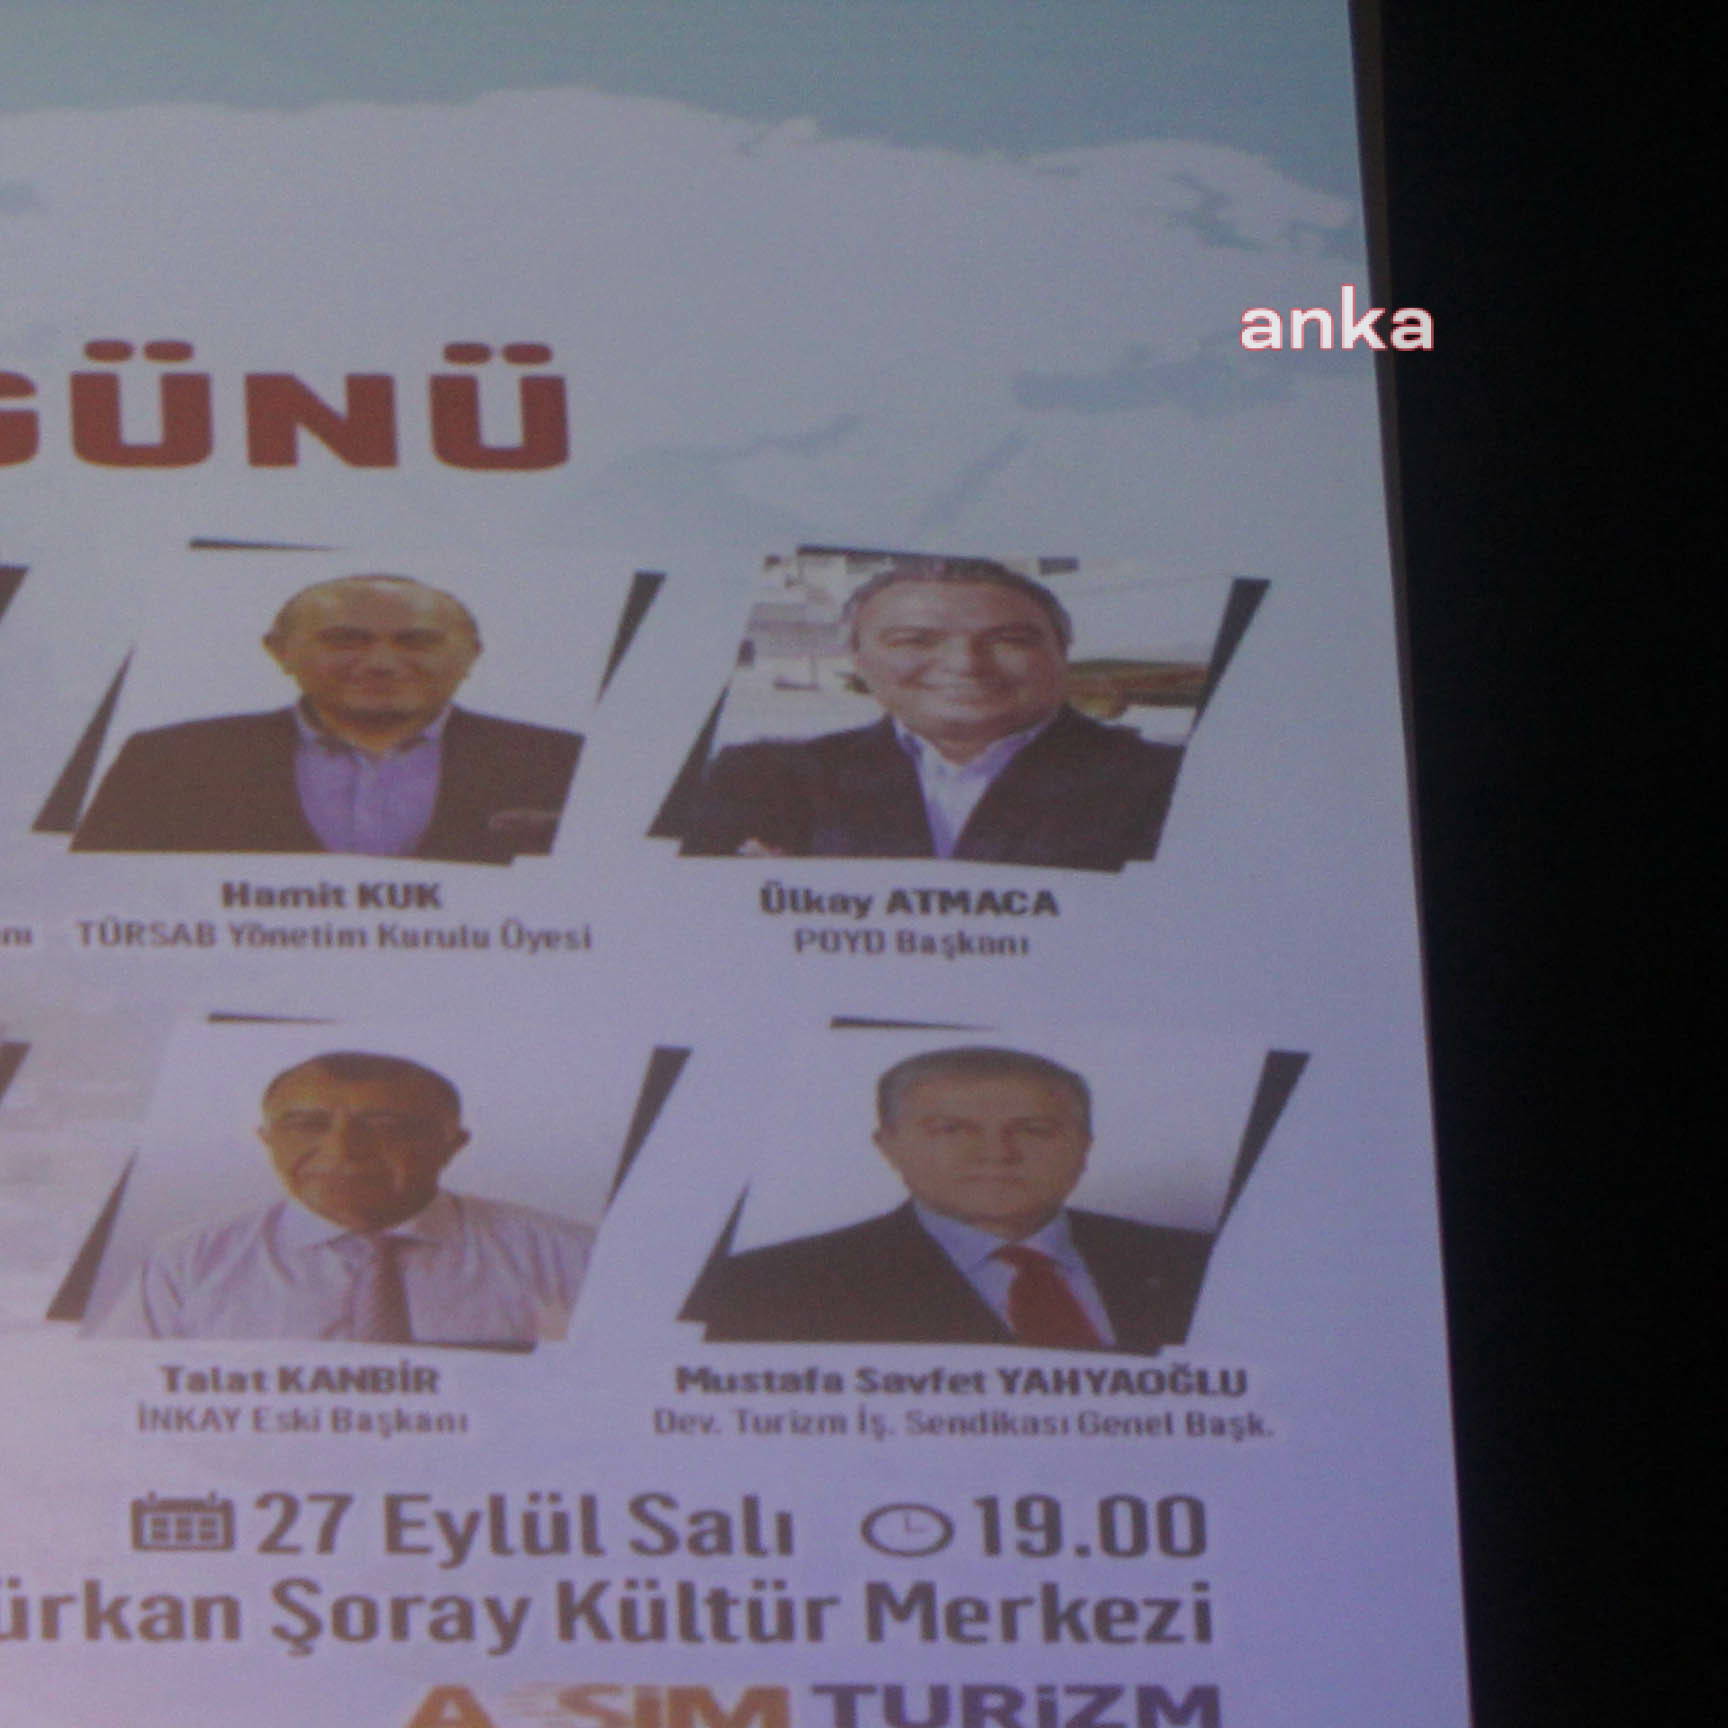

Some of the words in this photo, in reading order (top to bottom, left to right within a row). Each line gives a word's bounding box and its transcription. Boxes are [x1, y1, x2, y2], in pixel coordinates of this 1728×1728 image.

[221, 882, 347, 909] Hamit
[357, 883, 443, 910] KUK
[759, 881, 872, 920] Ülkay
[885, 887, 1060, 918] ATMACA
[77, 917, 216, 948] TÜRSAB
[228, 921, 367, 949] Yönetim
[378, 922, 490, 950] Kurulu
[500, 917, 594, 956] Üyesi
[896, 928, 1029, 961] Başkanı
[160, 1364, 267, 1394] Talat
[276, 1359, 441, 1395] KANBİR
[673, 1366, 843, 1396] Mustafa
[998, 1361, 1248, 1398] YAHYAOĞLU
[252, 1405, 321, 1433] Eski
[330, 1406, 469, 1439] Başkanı
[653, 1408, 721, 1436] Dev.
[736, 1408, 845, 1436] Turizm
[904, 1409, 1069, 1438] Sendikası
[1077, 1411, 1173, 1439] Genel
[1186, 1411, 1276, 1444] Başk.
[253, 1492, 355, 1558] 27
[380, 1488, 604, 1572] Eylül
[627, 1490, 796, 1558] Salı
[973, 1493, 1209, 1559] 19.00
[270, 1575, 537, 1658] Şoray
[558, 1578, 842, 1646] Kültür
[866, 1580, 1216, 1647] Merkezi
